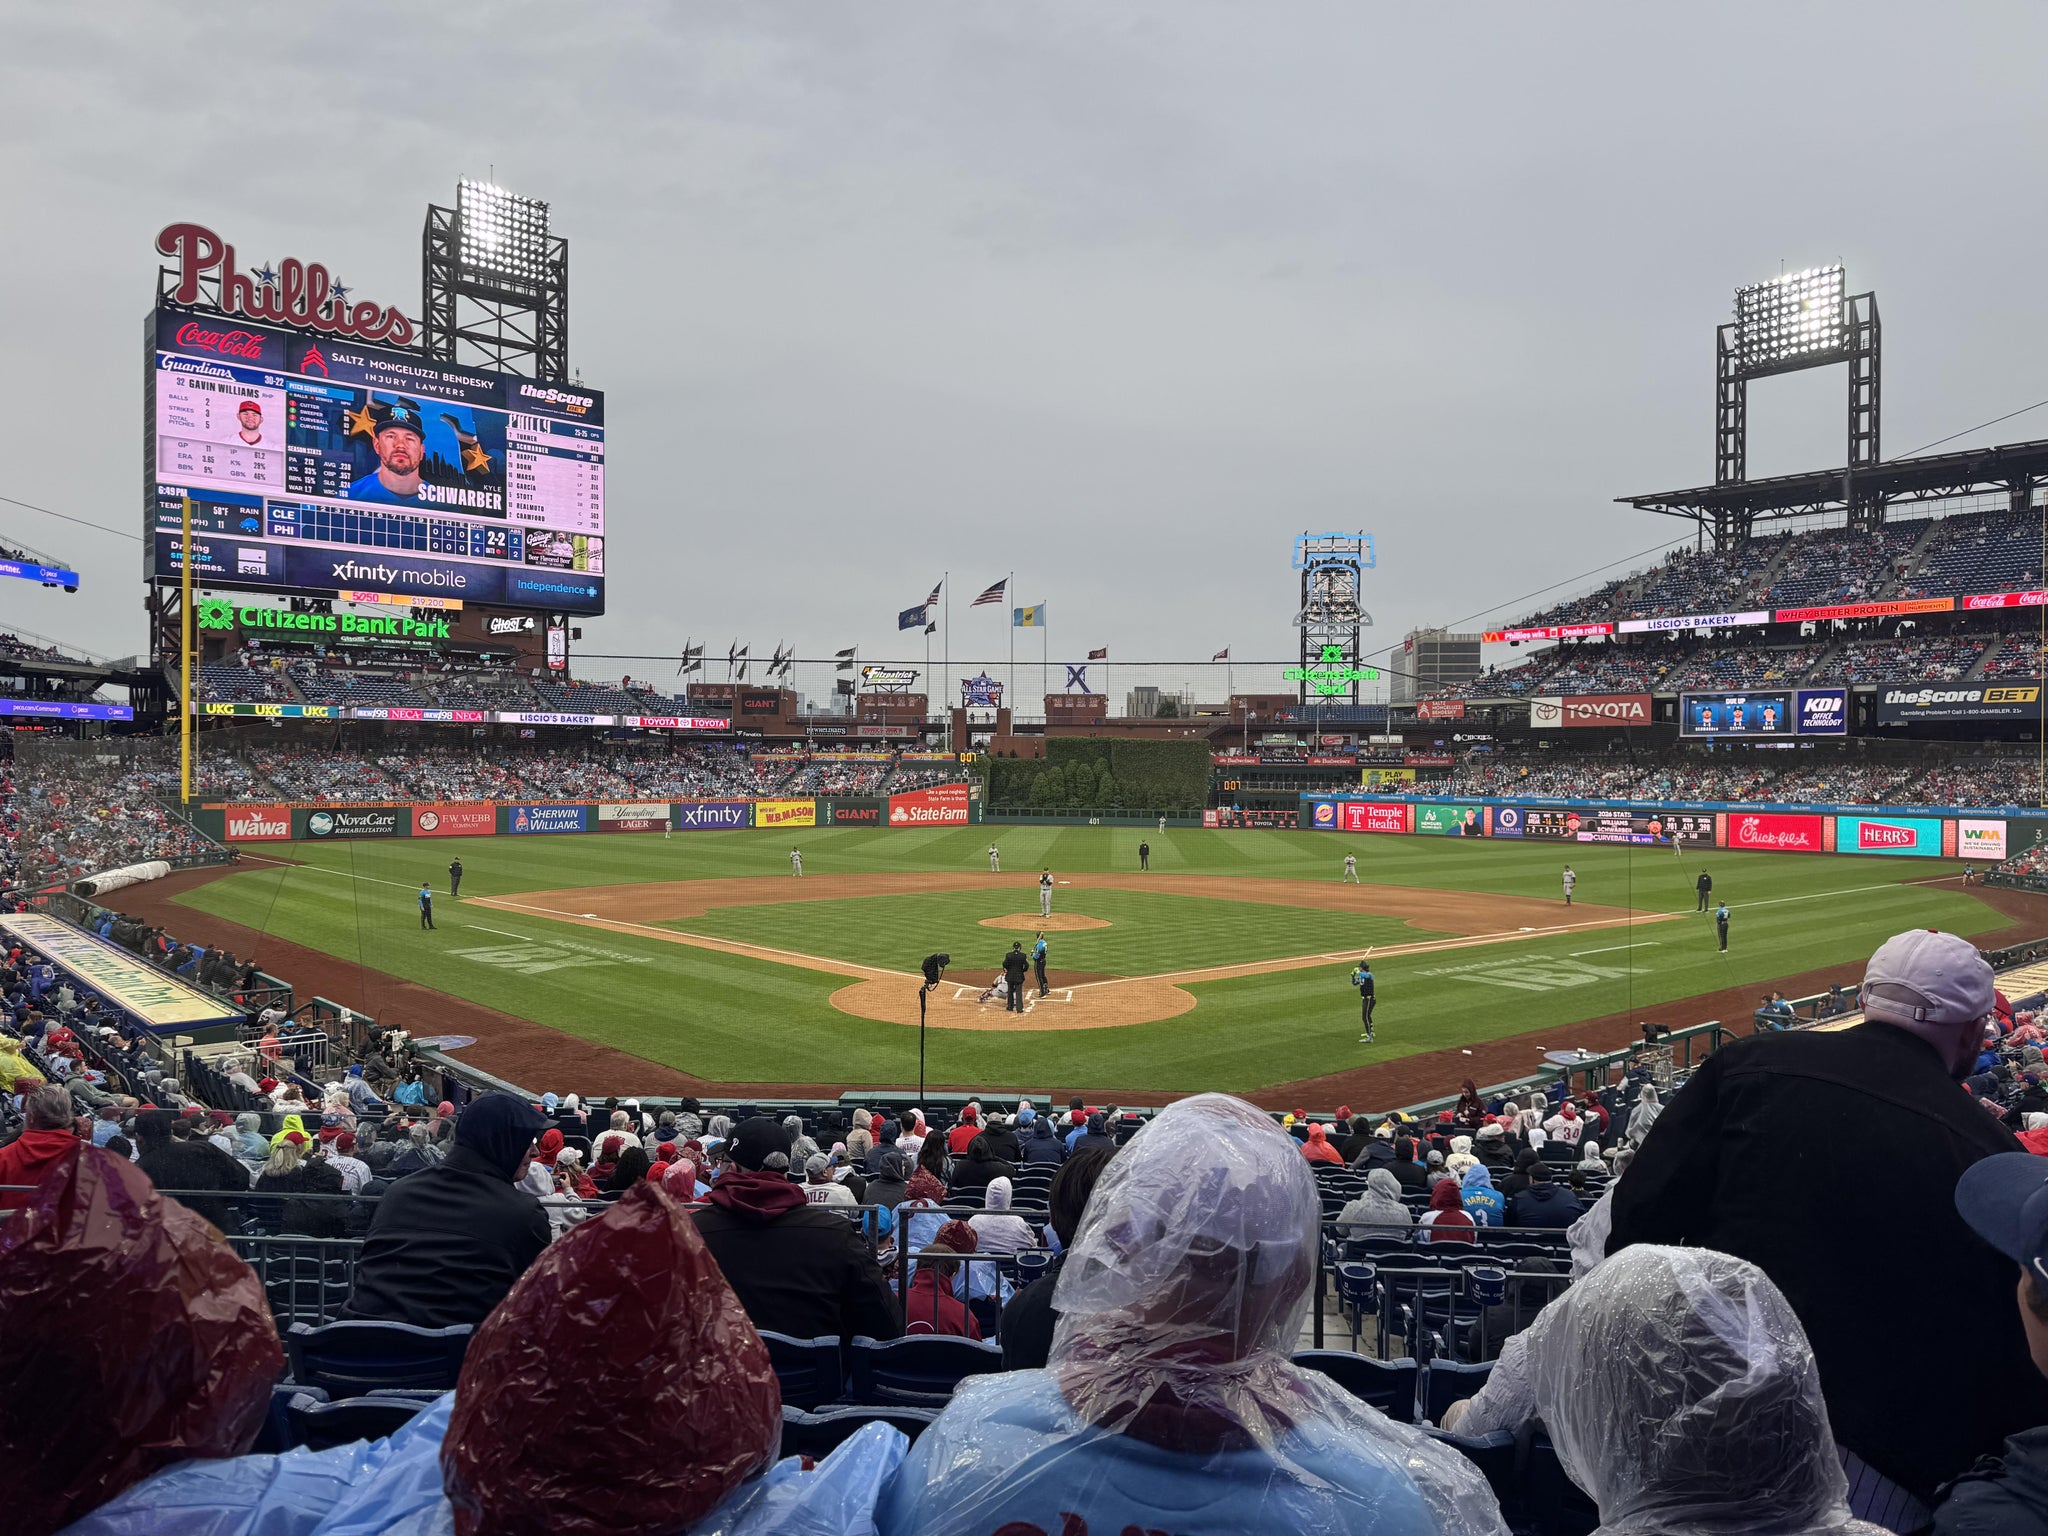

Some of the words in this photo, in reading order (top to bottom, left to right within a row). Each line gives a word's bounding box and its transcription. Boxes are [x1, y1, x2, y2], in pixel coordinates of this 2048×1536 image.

[156, 222, 414, 346] Phillies
[176, 321, 267, 359] Coca-Cola
[161, 355, 237, 382] Guardians
[331, 352, 365, 367] SALTZ
[369, 359, 438, 380] MONGELUZZI
[442, 372, 494, 390] BENDESKY
[264, 375, 284, 388] 30-22
[365, 373, 407, 387] INJURY
[415, 382, 465, 397] LAWYERS
[189, 379, 216, 391] GAVIN
[218, 383, 260, 399] WILLIAMS
[520, 384, 593, 407] theScore
[168, 405, 194, 413] STRIKES
[168, 419, 195, 428] PITCHES
[516, 433, 537, 442] TURNER
[516, 452, 537, 462] HARPER
[158, 486, 175, 496] 6:49
[177, 488, 188, 497] PM
[483, 484, 502, 493] KYLE
[417, 483, 502, 511] SCHWARBER
[516, 493, 533, 501] STOTT
[160, 501, 183, 509] TEMP
[240, 507, 259, 515] RAIN
[272, 509, 295, 520] CLE
[160, 515, 182, 523] WIND
[274, 525, 294, 535] PHI
[487, 530, 506, 547] 2-2
[170, 541, 210, 554] Drving
[170, 552, 212, 561] smrter
[170, 561, 226, 572] oucomes.
[332, 560, 398, 584] xfinity
[403, 569, 466, 588] mobile
[517, 580, 585, 595] Independence
[1969, 594, 2006, 608] Coca-Cola
[1781, 611, 1812, 620] WHEY
[1814, 608, 1851, 618] BETTER
[1853, 605, 1899, 616] PROTEIN
[239, 606, 336, 631] Citizens
[341, 614, 397, 636] Bank
[402, 617, 450, 639] Park
[490, 617, 527, 634] GHOST
[1648, 618, 1691, 630] LISCIO'S
[1694, 615, 1737, 627] BAKERY
[1504, 630, 1531, 640] Phillies
[1532, 630, 1546, 639] win
[1562, 627, 1583, 636] Deals
[1584, 626, 1598, 635] roll
[1598, 626, 1606, 634] in
[868, 670, 913, 679] Fitzpatrick
[1284, 668, 1341, 680] Citizens
[1344, 668, 1380, 680] Bank
[961, 685, 972, 693] ALL
[972, 685, 986, 693] STAR
[988, 685, 1004, 693] GAME
[1885, 689, 1982, 704] theScore
[1988, 689, 2035, 701] BET
[206, 703, 234, 714] UKG
[744, 700, 776, 708] GIANT
[1804, 697, 1843, 712] KDI
[255, 705, 282, 716] UKG
[302, 706, 328, 717] UKG
[391, 710, 419, 718] NECA
[455, 711, 483, 720] NECA
[1567, 702, 1644, 720] TOYOTA
[1812, 712, 1833, 720] OFFICE
[1900, 709, 1925, 717] Gambling
[520, 714, 558, 723] LISCIO'S
[560, 715, 596, 724] BAKERY
[643, 717, 675, 727] TOYOTA
[694, 718, 725, 728] TOYOTA
[1803, 719, 1843, 727] TECHNOLOGY
[960, 753, 977, 763] 0:07
[1224, 781, 1240, 791] 0:07
[531, 808, 579, 819] SHERWIN
[612, 806, 657, 818] Yuengling
[685, 804, 742, 826] xfinity
[835, 810, 878, 819] GIANT
[1367, 806, 1402, 819] Temple
[335, 813, 395, 827] NovaCare
[442, 814, 459, 823] F.W.
[461, 814, 490, 823] WEBB
[1367, 819, 1400, 829] Health
[229, 819, 287, 837] Wawa
[335, 826, 392, 834] REHABILITATION
[620, 820, 649, 829] LAGER
[1594, 834, 1629, 842] CURVEBALL
[1740, 820, 1809, 847] Chick-fil-A
[1864, 827, 1910, 843] HERR'S
[1964, 830, 2000, 840] WM
[1563, 1127, 1579, 1140] 34
[1465, 1195, 1495, 1207] HARPER
